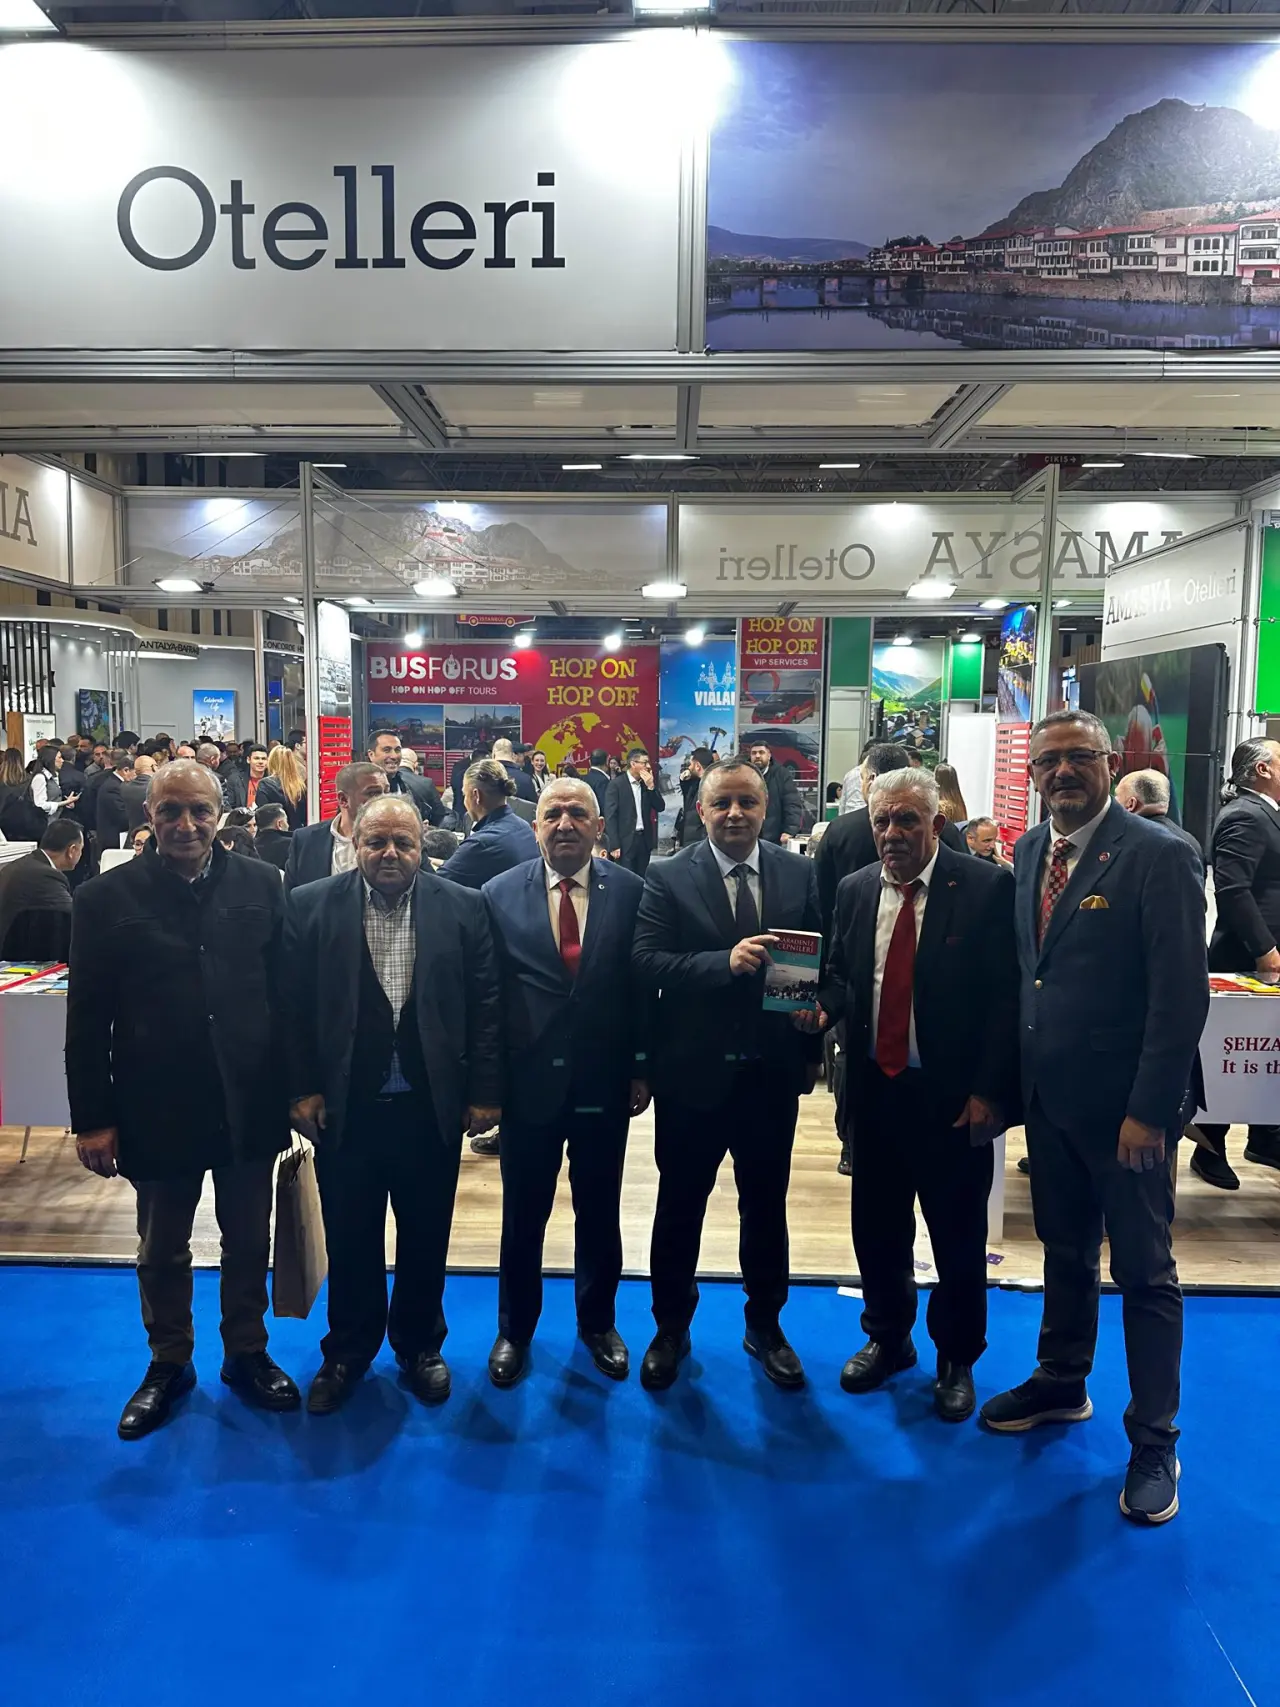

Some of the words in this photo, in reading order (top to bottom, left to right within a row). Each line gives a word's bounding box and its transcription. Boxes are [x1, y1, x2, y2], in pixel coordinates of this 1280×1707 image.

[116, 164, 566, 271] Otelleri
[1184, 568, 1237, 606] Otelleri
[748, 617, 785, 633] HOP
[788, 617, 816, 633] ON
[745, 638, 782, 655] HOP
[785, 638, 817, 655] OFF
[370, 654, 519, 681] BUSFORUS
[550, 657, 598, 679] HOP
[601, 657, 637, 679] ON
[753, 658, 768, 666] VIP
[769, 658, 809, 667] SERVICES
[391, 686, 411, 695] HOP
[412, 686, 426, 695] ON
[427, 686, 447, 695] HOP
[449, 686, 465, 695] OFF
[469, 687, 498, 696] TOURS
[546, 685, 594, 707] HOP
[598, 685, 640, 707] OFF
[1221, 1059, 1237, 1074] It
[1243, 1059, 1258, 1074] is
